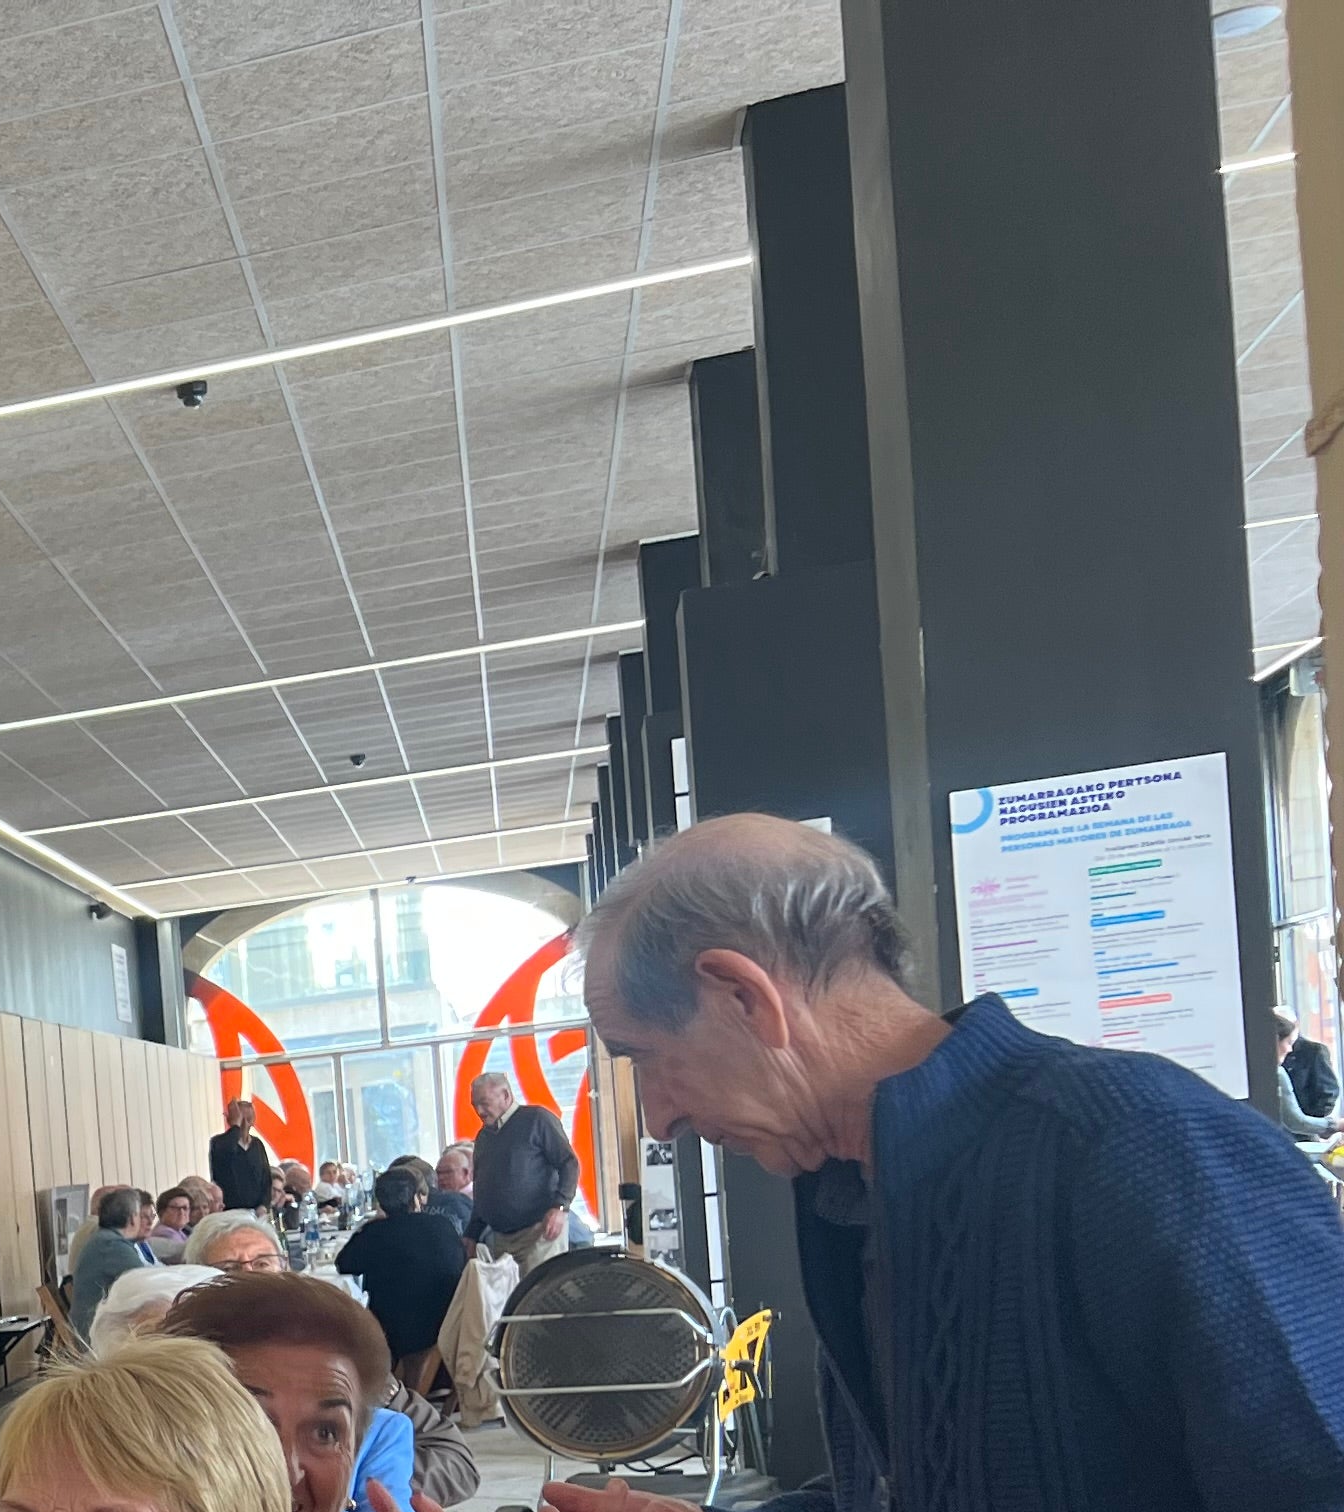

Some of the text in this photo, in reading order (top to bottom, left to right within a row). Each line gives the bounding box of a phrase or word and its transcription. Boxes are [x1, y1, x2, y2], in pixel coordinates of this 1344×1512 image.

[998, 771, 1182, 805] ZUMARRAGAKO PERTSONA
[1071, 790, 1125, 805] ASTEKO
[1000, 803, 1111, 825] PROGRAMAZIOA
